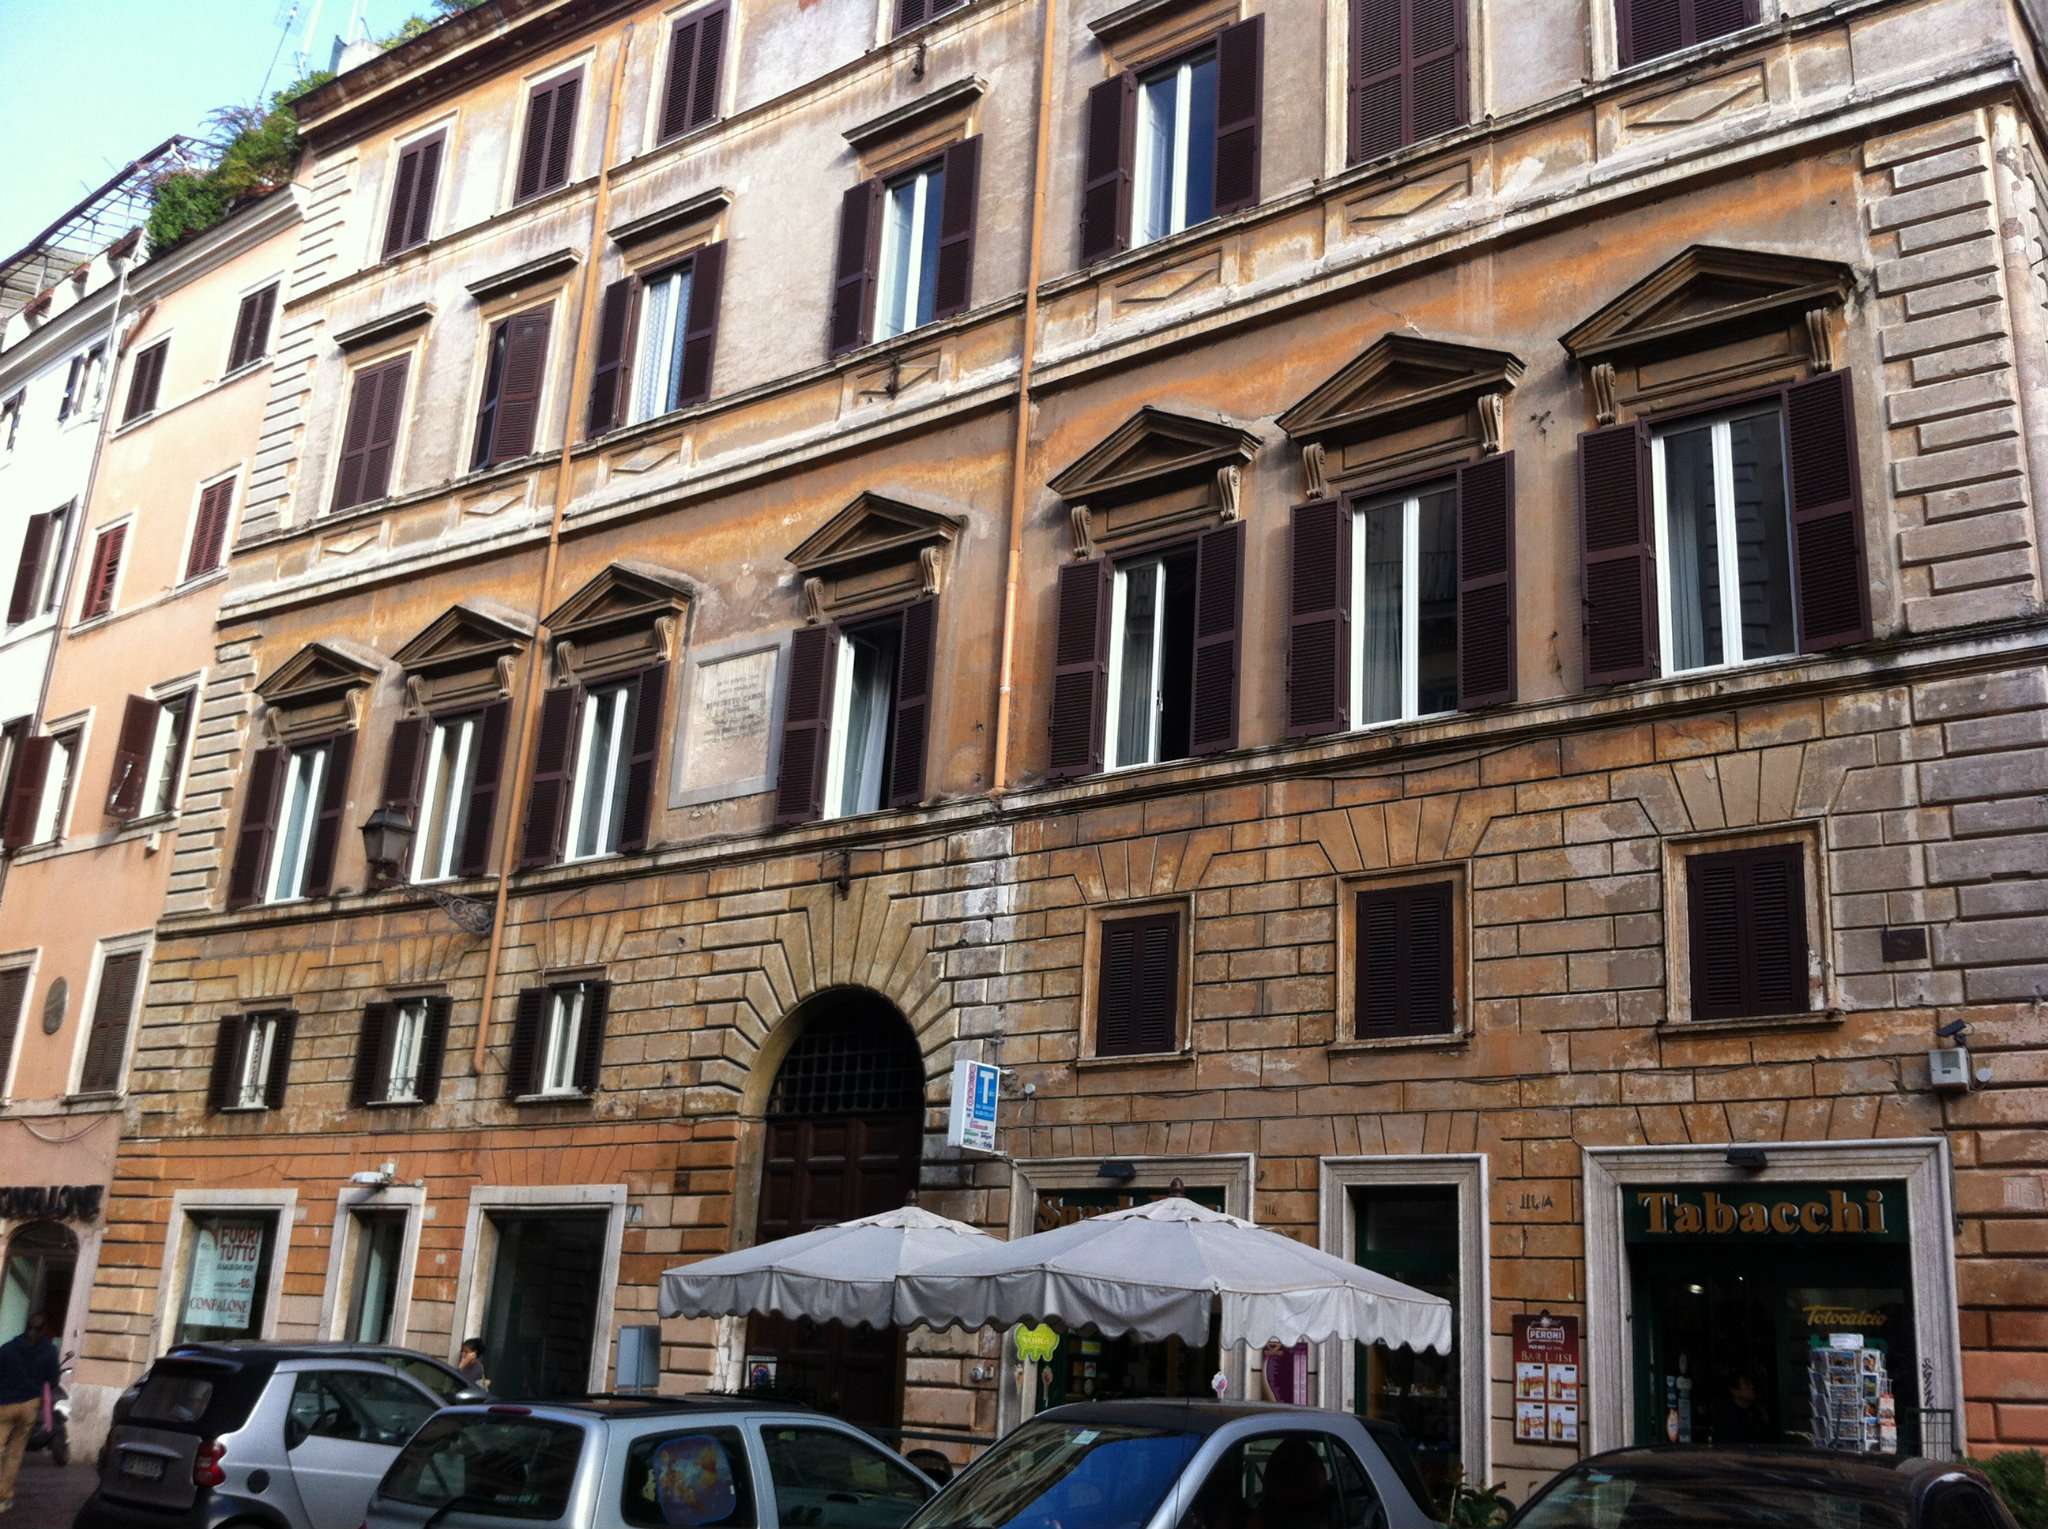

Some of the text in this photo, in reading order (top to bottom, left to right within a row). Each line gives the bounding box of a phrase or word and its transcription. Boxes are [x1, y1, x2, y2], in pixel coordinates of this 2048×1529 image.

[1637, 1189, 1889, 1234] Tabacchi
[221, 1225, 261, 1245] FUORI
[220, 1244, 257, 1262] TUTTO
[1530, 1329, 1562, 1340] PERONI
